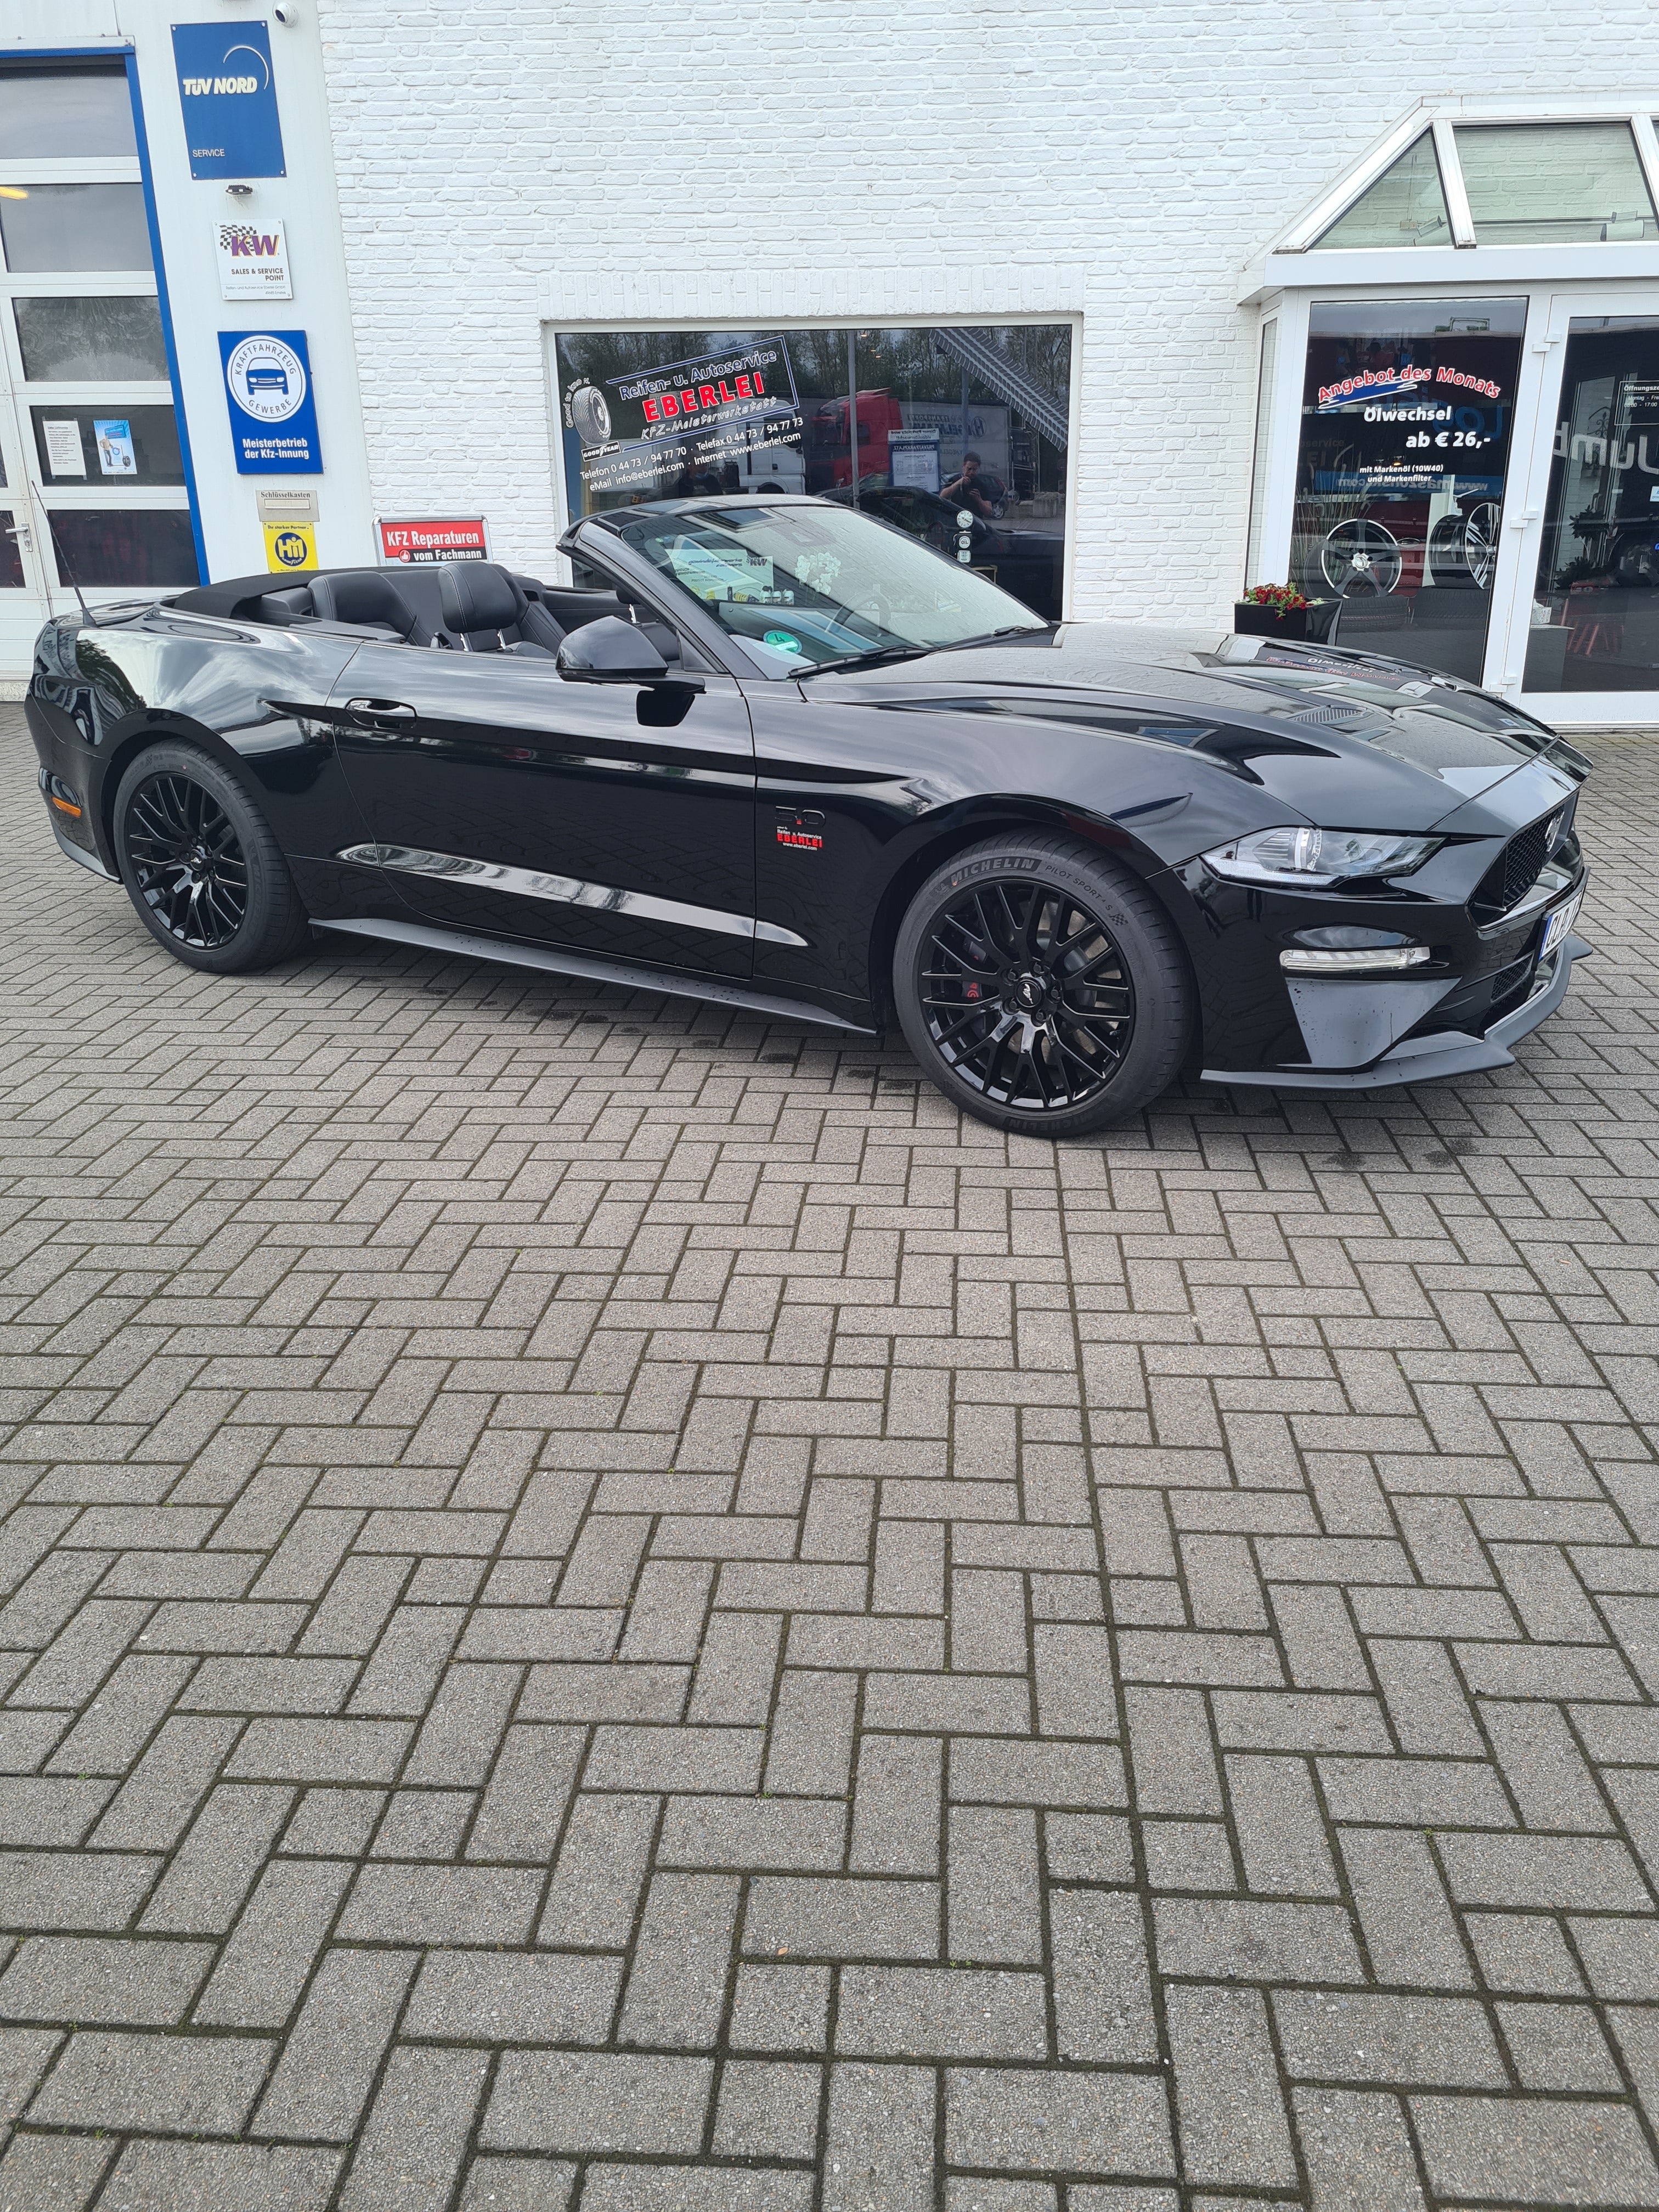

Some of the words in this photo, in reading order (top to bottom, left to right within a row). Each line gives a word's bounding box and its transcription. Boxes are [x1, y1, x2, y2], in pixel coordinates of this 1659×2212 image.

[183, 78, 212, 95] TÜV
[213, 77, 258, 94] NORD
[193, 149, 225, 157] SERVICE
[230, 234, 279, 257] KW
[235, 344, 296, 375] KRAFTFAHRZEUG
[619, 379, 671, 400] Reifen-
[691, 350, 777, 382] Autoservice
[1318, 367, 1395, 403] Angebot
[1400, 364, 1431, 381] des
[1436, 366, 1500, 399] Monats
[642, 371, 765, 422] EBERLEI
[249, 398, 291, 414] GEWERBE
[1364, 405, 1452, 422] Ölwechsel
[641, 396, 777, 441] KFZ-Meisterwerkstatt
[242, 438, 308, 448] Meisterbetrieb
[580, 466, 610, 481] Telefon
[611, 464, 617, 473] 0
[619, 461, 630, 470] 44
[630, 458, 641, 467] 73
[644, 455, 648, 465] /
[651, 453, 662, 462] 94
[663, 450, 674, 459] 77
[675, 447, 686, 456] 70
[696, 439, 725, 451] Telefax
[726, 435, 732, 443] 0
[734, 432, 745, 441] 44
[746, 429, 758, 438] 73
[760, 426, 764, 436] /
[767, 424, 778, 433] 94
[780, 420, 790, 430] 77
[792, 417, 803, 427] 73
[1406, 431, 1430, 448] ab
[1434, 432, 1449, 448] €
[1453, 431, 1491, 449] 26,-
[245, 449, 258, 458] der
[261, 449, 309, 460] Kfz-Innung
[590, 478, 612, 491] eMail
[616, 461, 684, 486] info@eberlei.com
[694, 452, 727, 465] Internet
[730, 433, 801, 456] www.eberlei.com
[1412, 465, 1444, 473] (10W40)
[386, 531, 409, 546] KFZ
[411, 530, 479, 548] Reparaturen
[413, 552, 433, 561] vom
[435, 549, 482, 560] Fachmann
[774, 634, 785, 642] 4
[777, 833, 822, 848] EBERLEI
[951, 858, 1035, 882] MICHELIN
[1045, 865, 1073, 879] PILOT
[1073, 878, 1102, 899] SPORT
